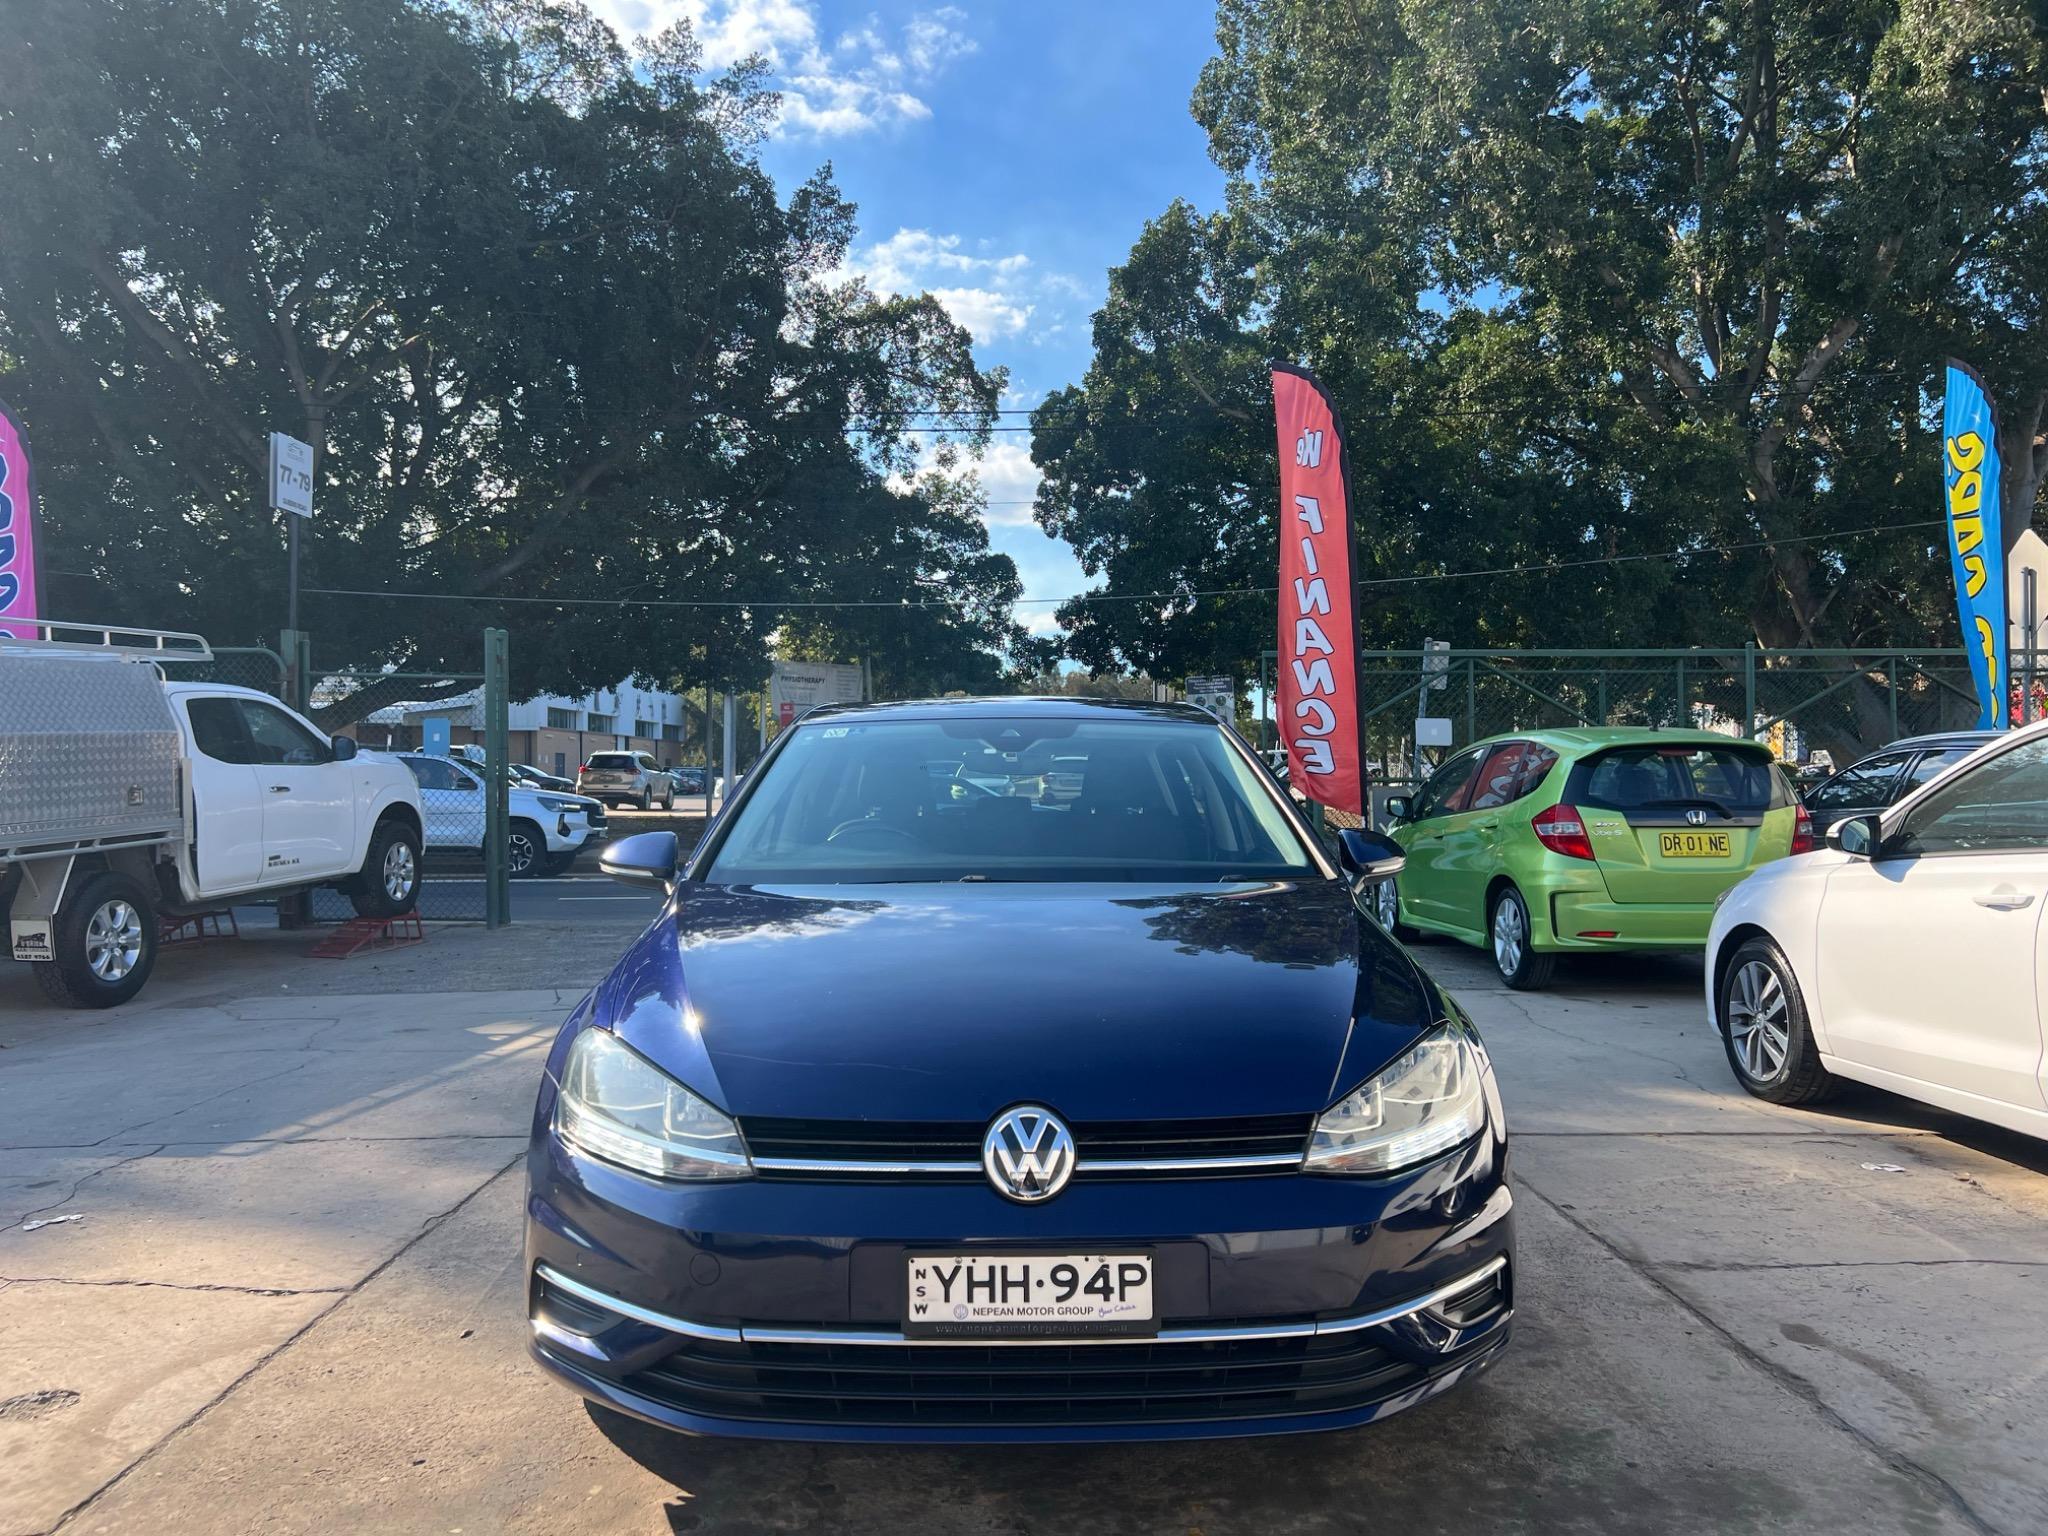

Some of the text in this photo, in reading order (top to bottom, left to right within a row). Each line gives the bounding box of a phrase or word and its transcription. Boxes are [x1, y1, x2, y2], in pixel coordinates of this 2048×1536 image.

[781, 675, 826, 685] PHYSIOTHERAPY
[973, 1306, 1094, 1316] NEPEAN MOTOR GROUP
